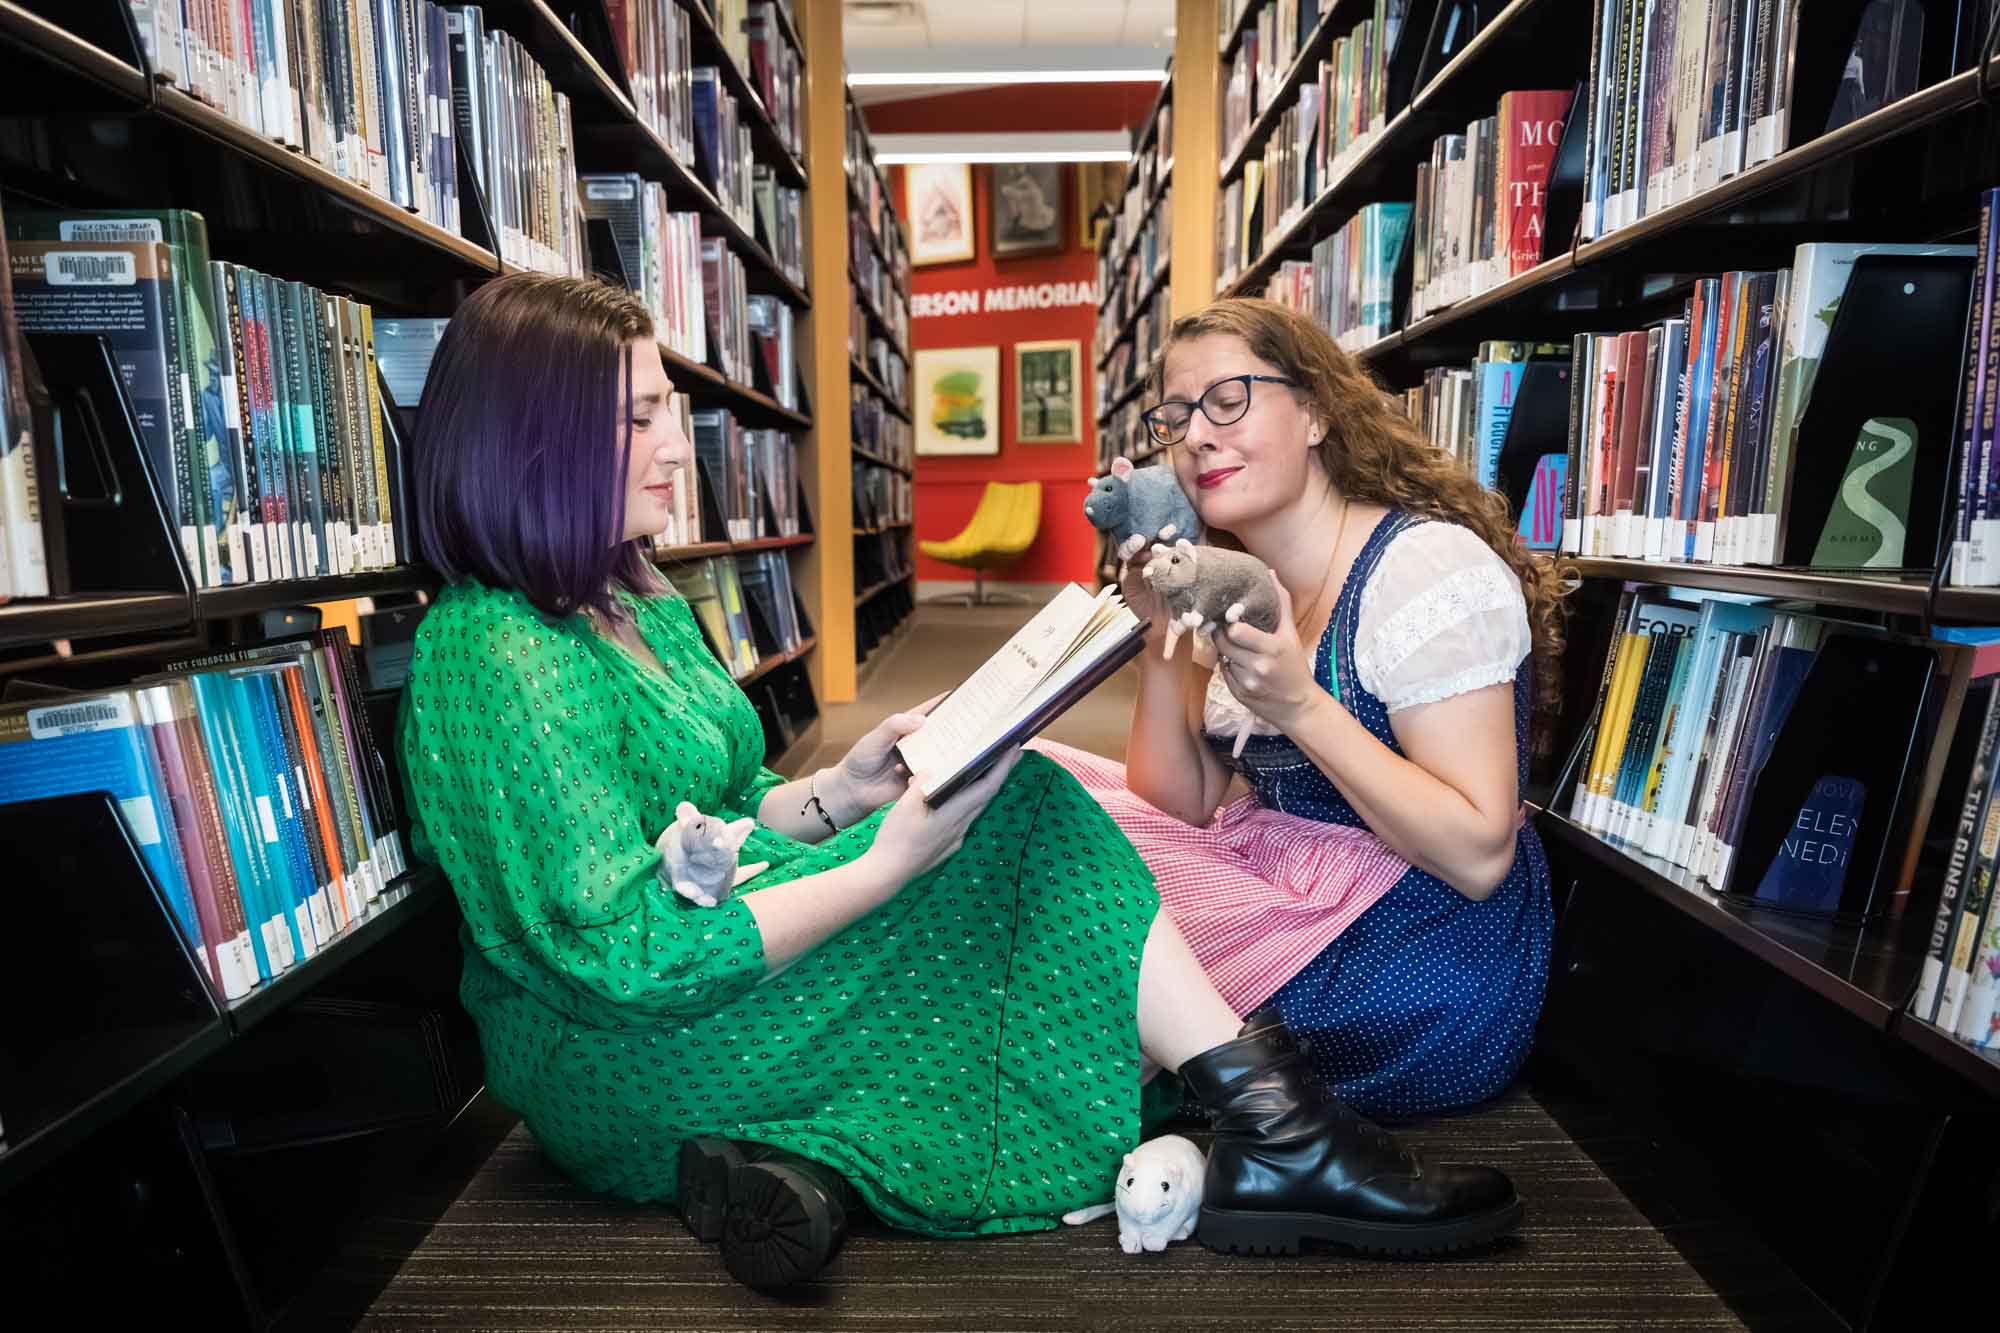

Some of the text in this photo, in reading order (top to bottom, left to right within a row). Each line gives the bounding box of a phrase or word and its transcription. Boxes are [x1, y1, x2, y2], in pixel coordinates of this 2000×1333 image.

[1612, 110, 1622, 188] ASSISTANT
[1626, 103, 1636, 183] ASSISTANT
[94, 223, 123, 231] CENTRAL
[124, 223, 152, 231] LIBRARY
[1970, 302, 1981, 348] WILD
[232, 304, 241, 344] BEST
[237, 350, 252, 436] AMERICAN
[1964, 353, 1977, 431] CYBERS
[1674, 373, 1685, 424] BELOW
[1706, 400, 1716, 442] NEWS
[1700, 471, 1708, 494] ME
[1957, 789, 1983, 836] THE
[1942, 837, 1970, 900] GUNS
